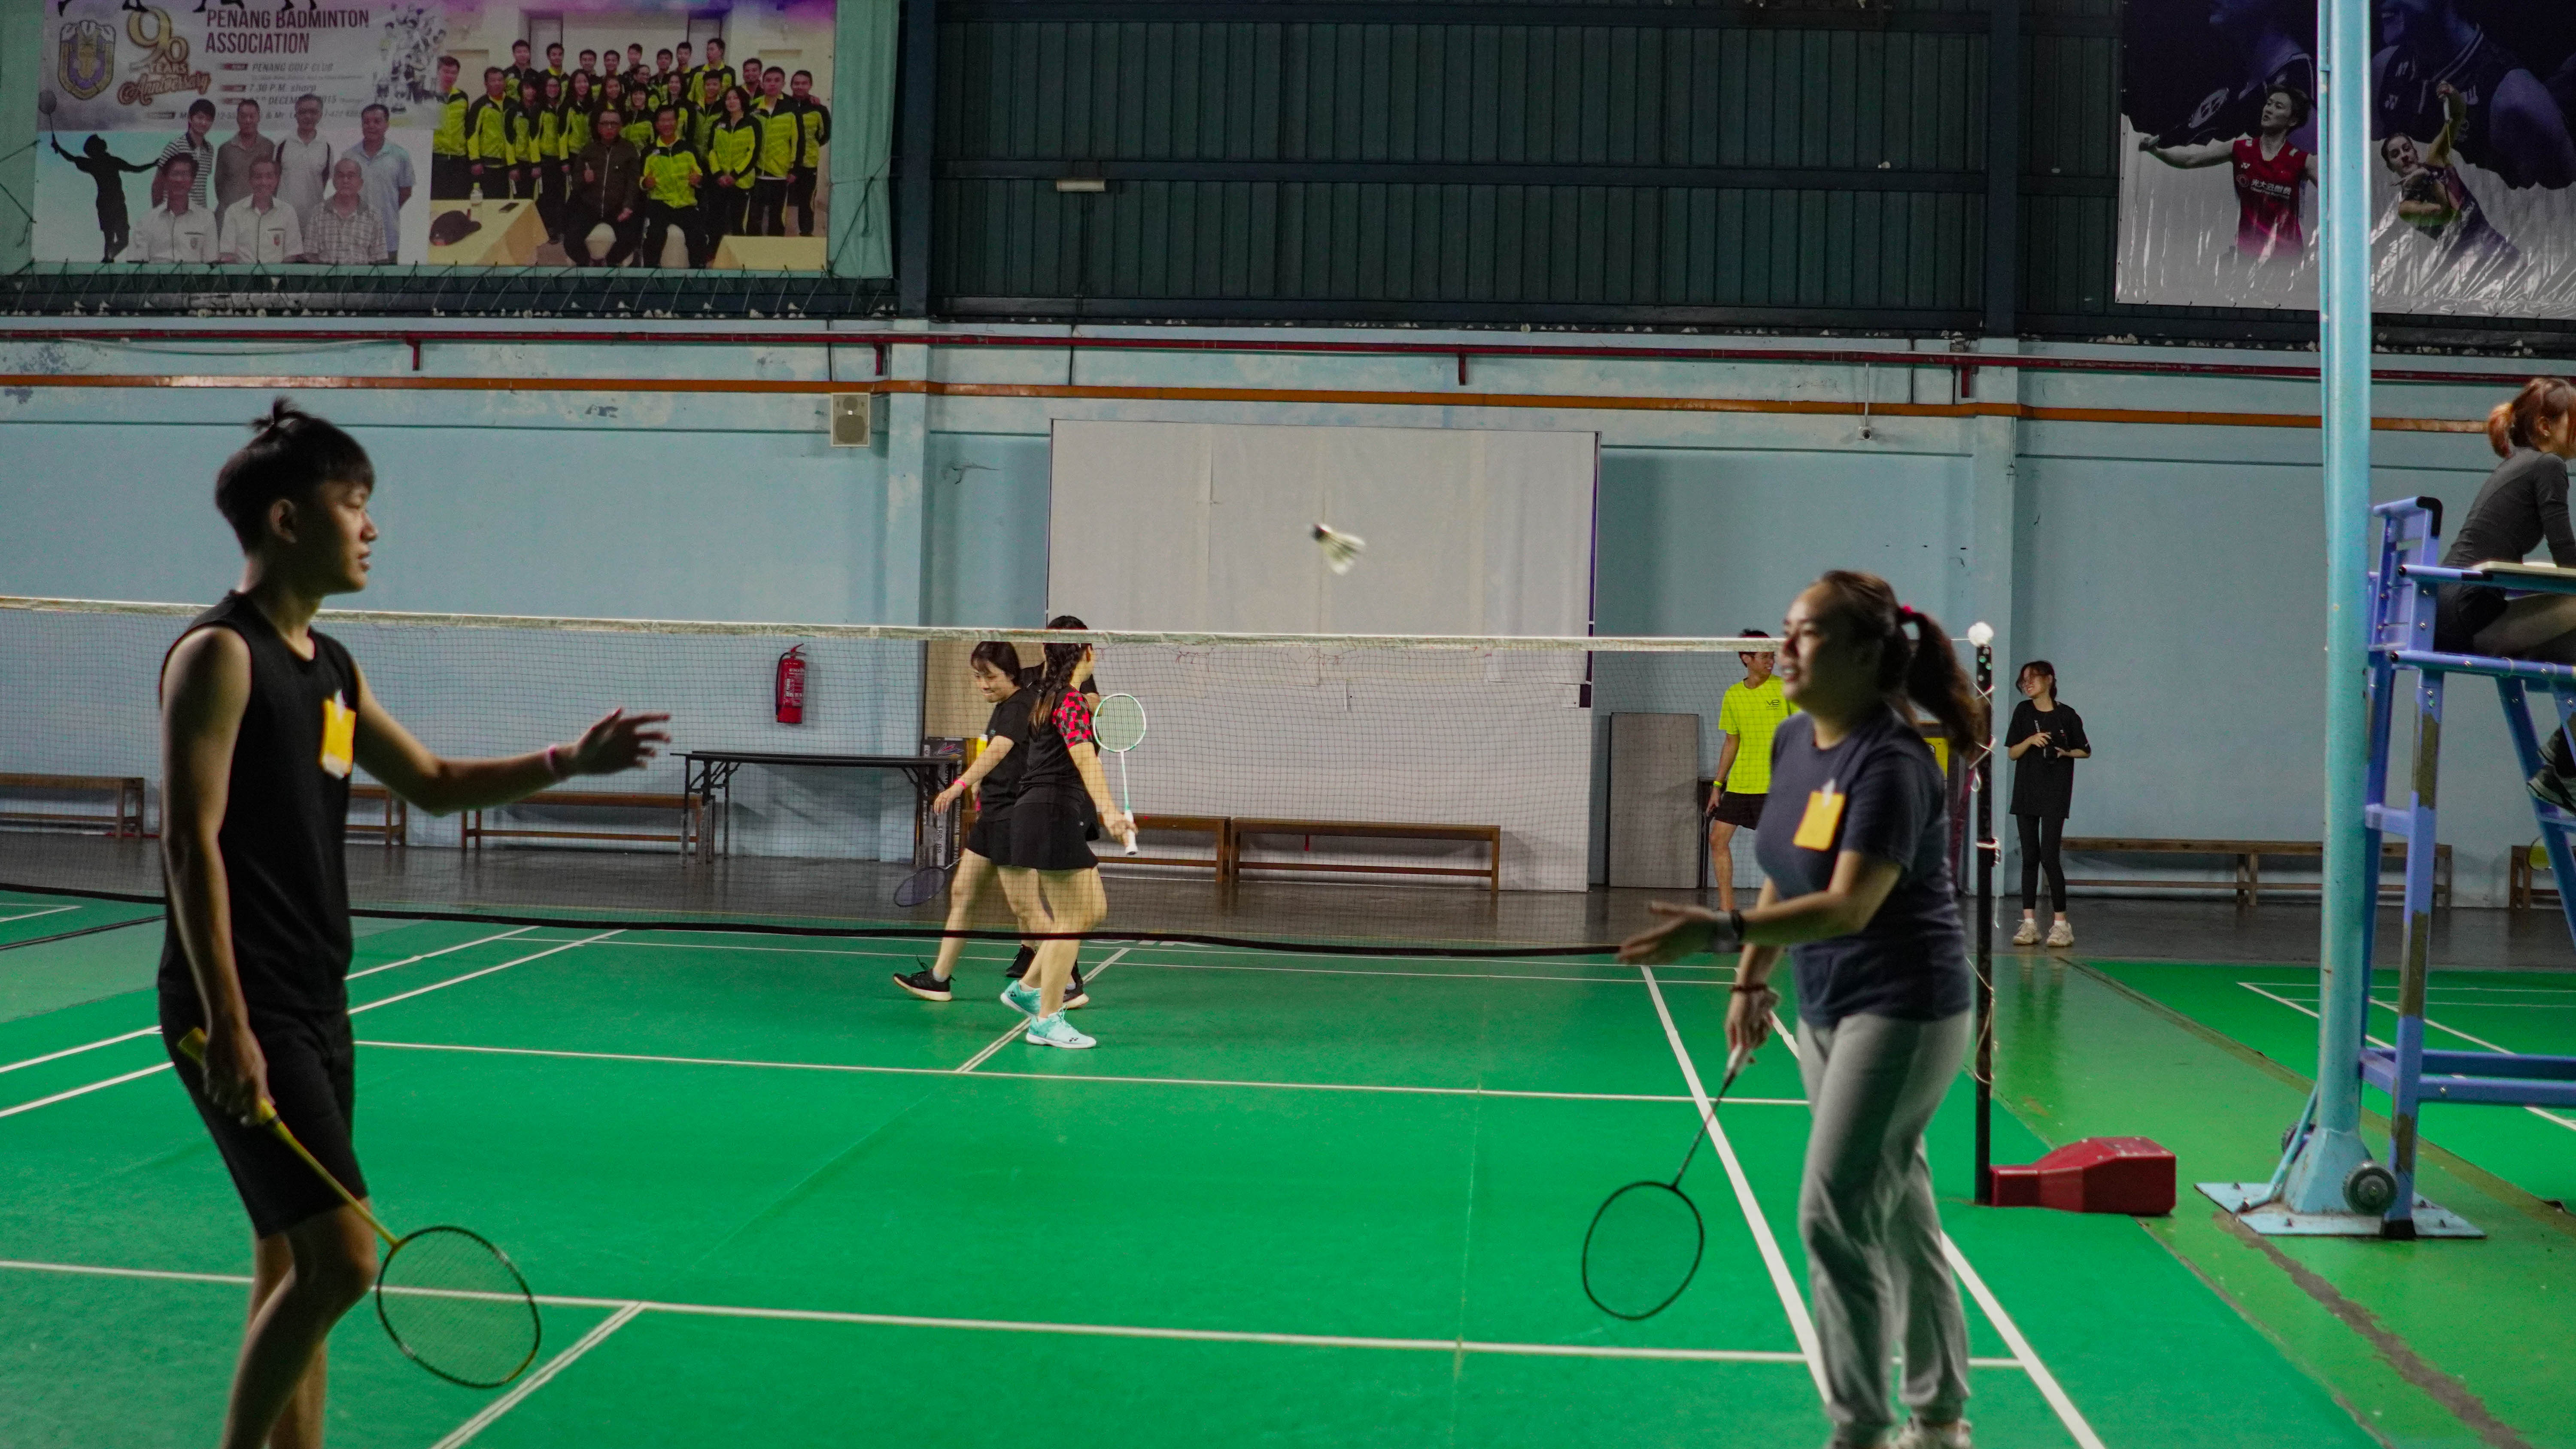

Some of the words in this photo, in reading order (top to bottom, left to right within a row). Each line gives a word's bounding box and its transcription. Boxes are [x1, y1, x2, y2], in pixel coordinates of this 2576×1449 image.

[207, 9, 271, 28] PENANG
[276, 9, 369, 28] BADMINTON
[205, 32, 310, 54] ASSOCIATION
[252, 63, 286, 72] PENANG
[288, 63, 308, 72] GOLF
